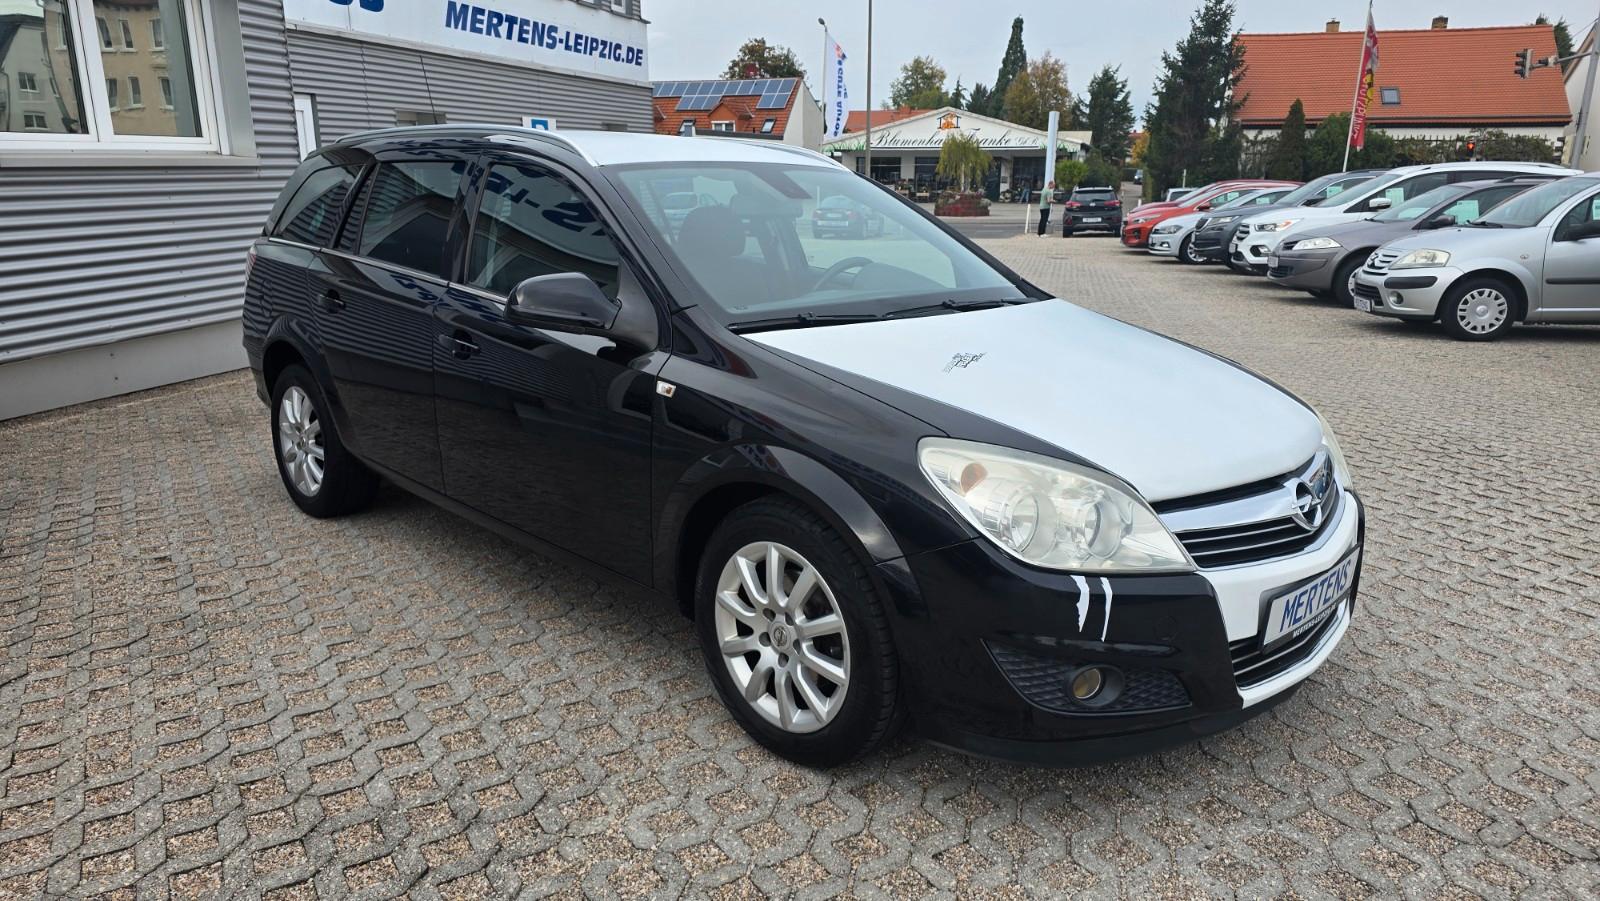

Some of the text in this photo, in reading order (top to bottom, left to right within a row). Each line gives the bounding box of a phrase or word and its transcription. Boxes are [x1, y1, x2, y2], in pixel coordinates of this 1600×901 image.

[445, 0, 643, 66] MERTENS-LEIPZIG.DE
[871, 129, 945, 146] Blumenha
[966, 127, 1011, 146] Fanke
[1280, 559, 1351, 632] MERTENS
